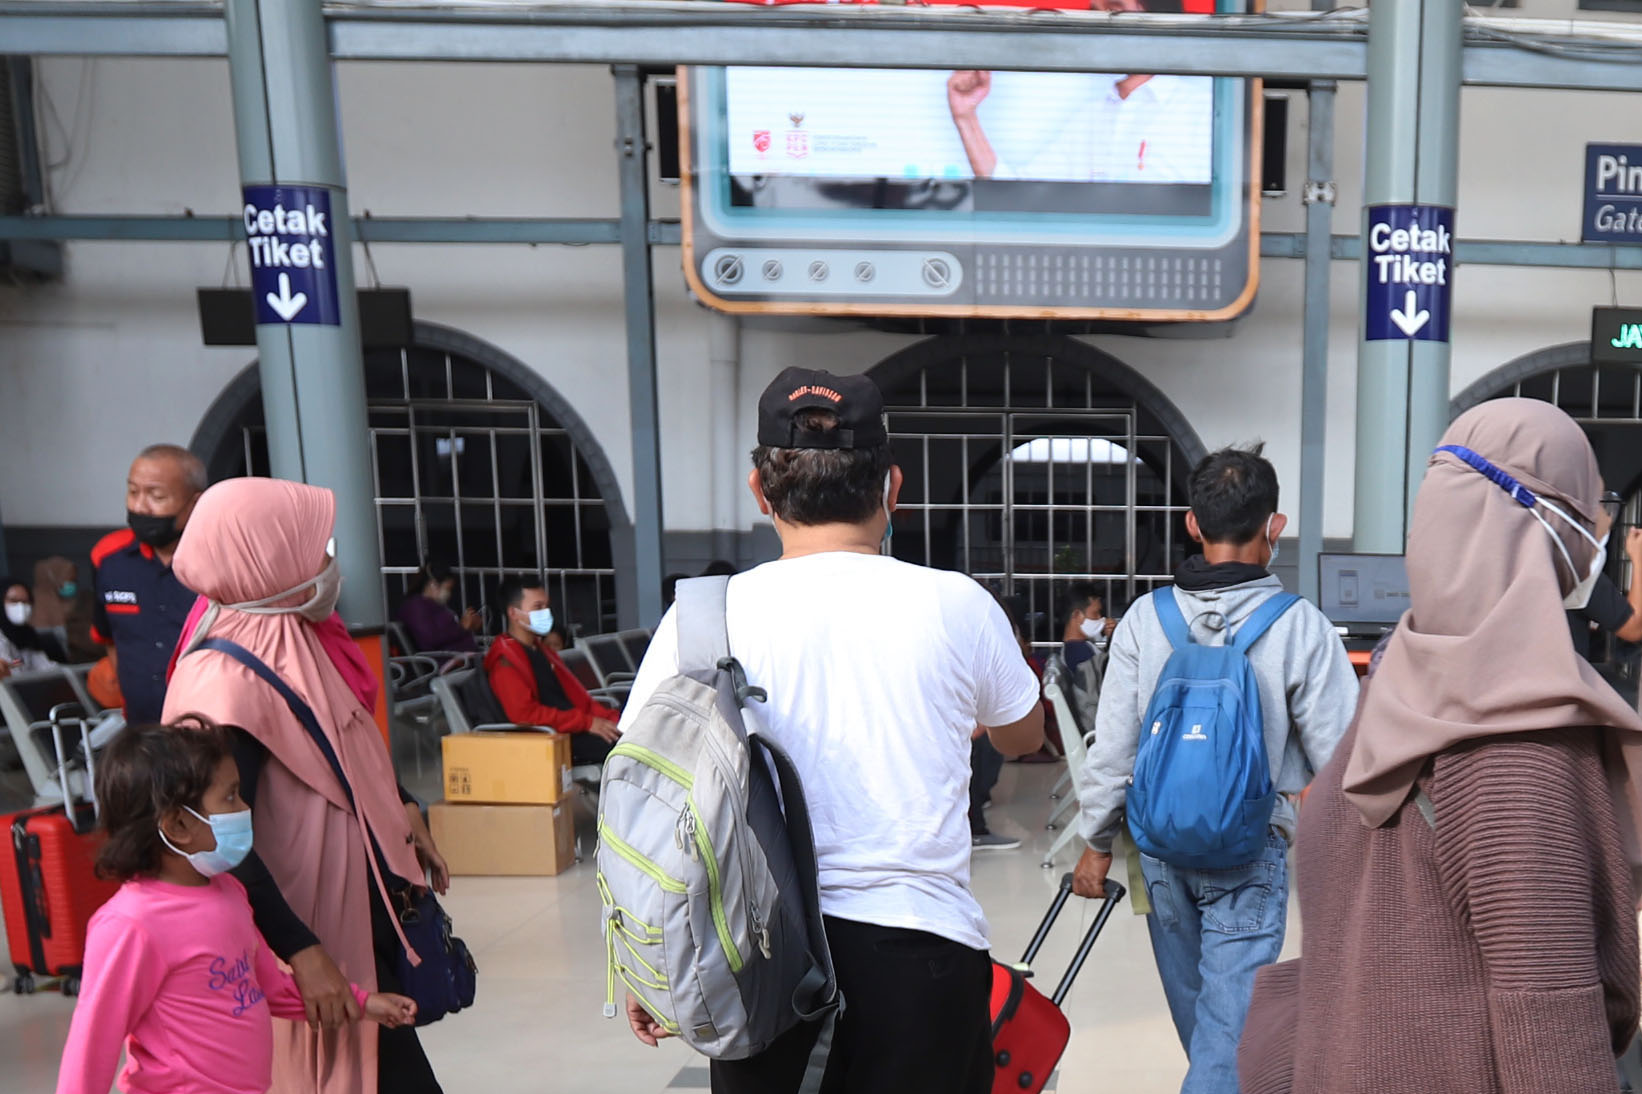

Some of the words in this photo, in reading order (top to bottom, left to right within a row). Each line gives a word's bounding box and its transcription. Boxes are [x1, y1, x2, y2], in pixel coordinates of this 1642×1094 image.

[243, 203, 328, 237] Cetak
[249, 235, 325, 269] Tiket
[1370, 222, 1451, 253] Cetak
[1374, 254, 1446, 285] Tiket
